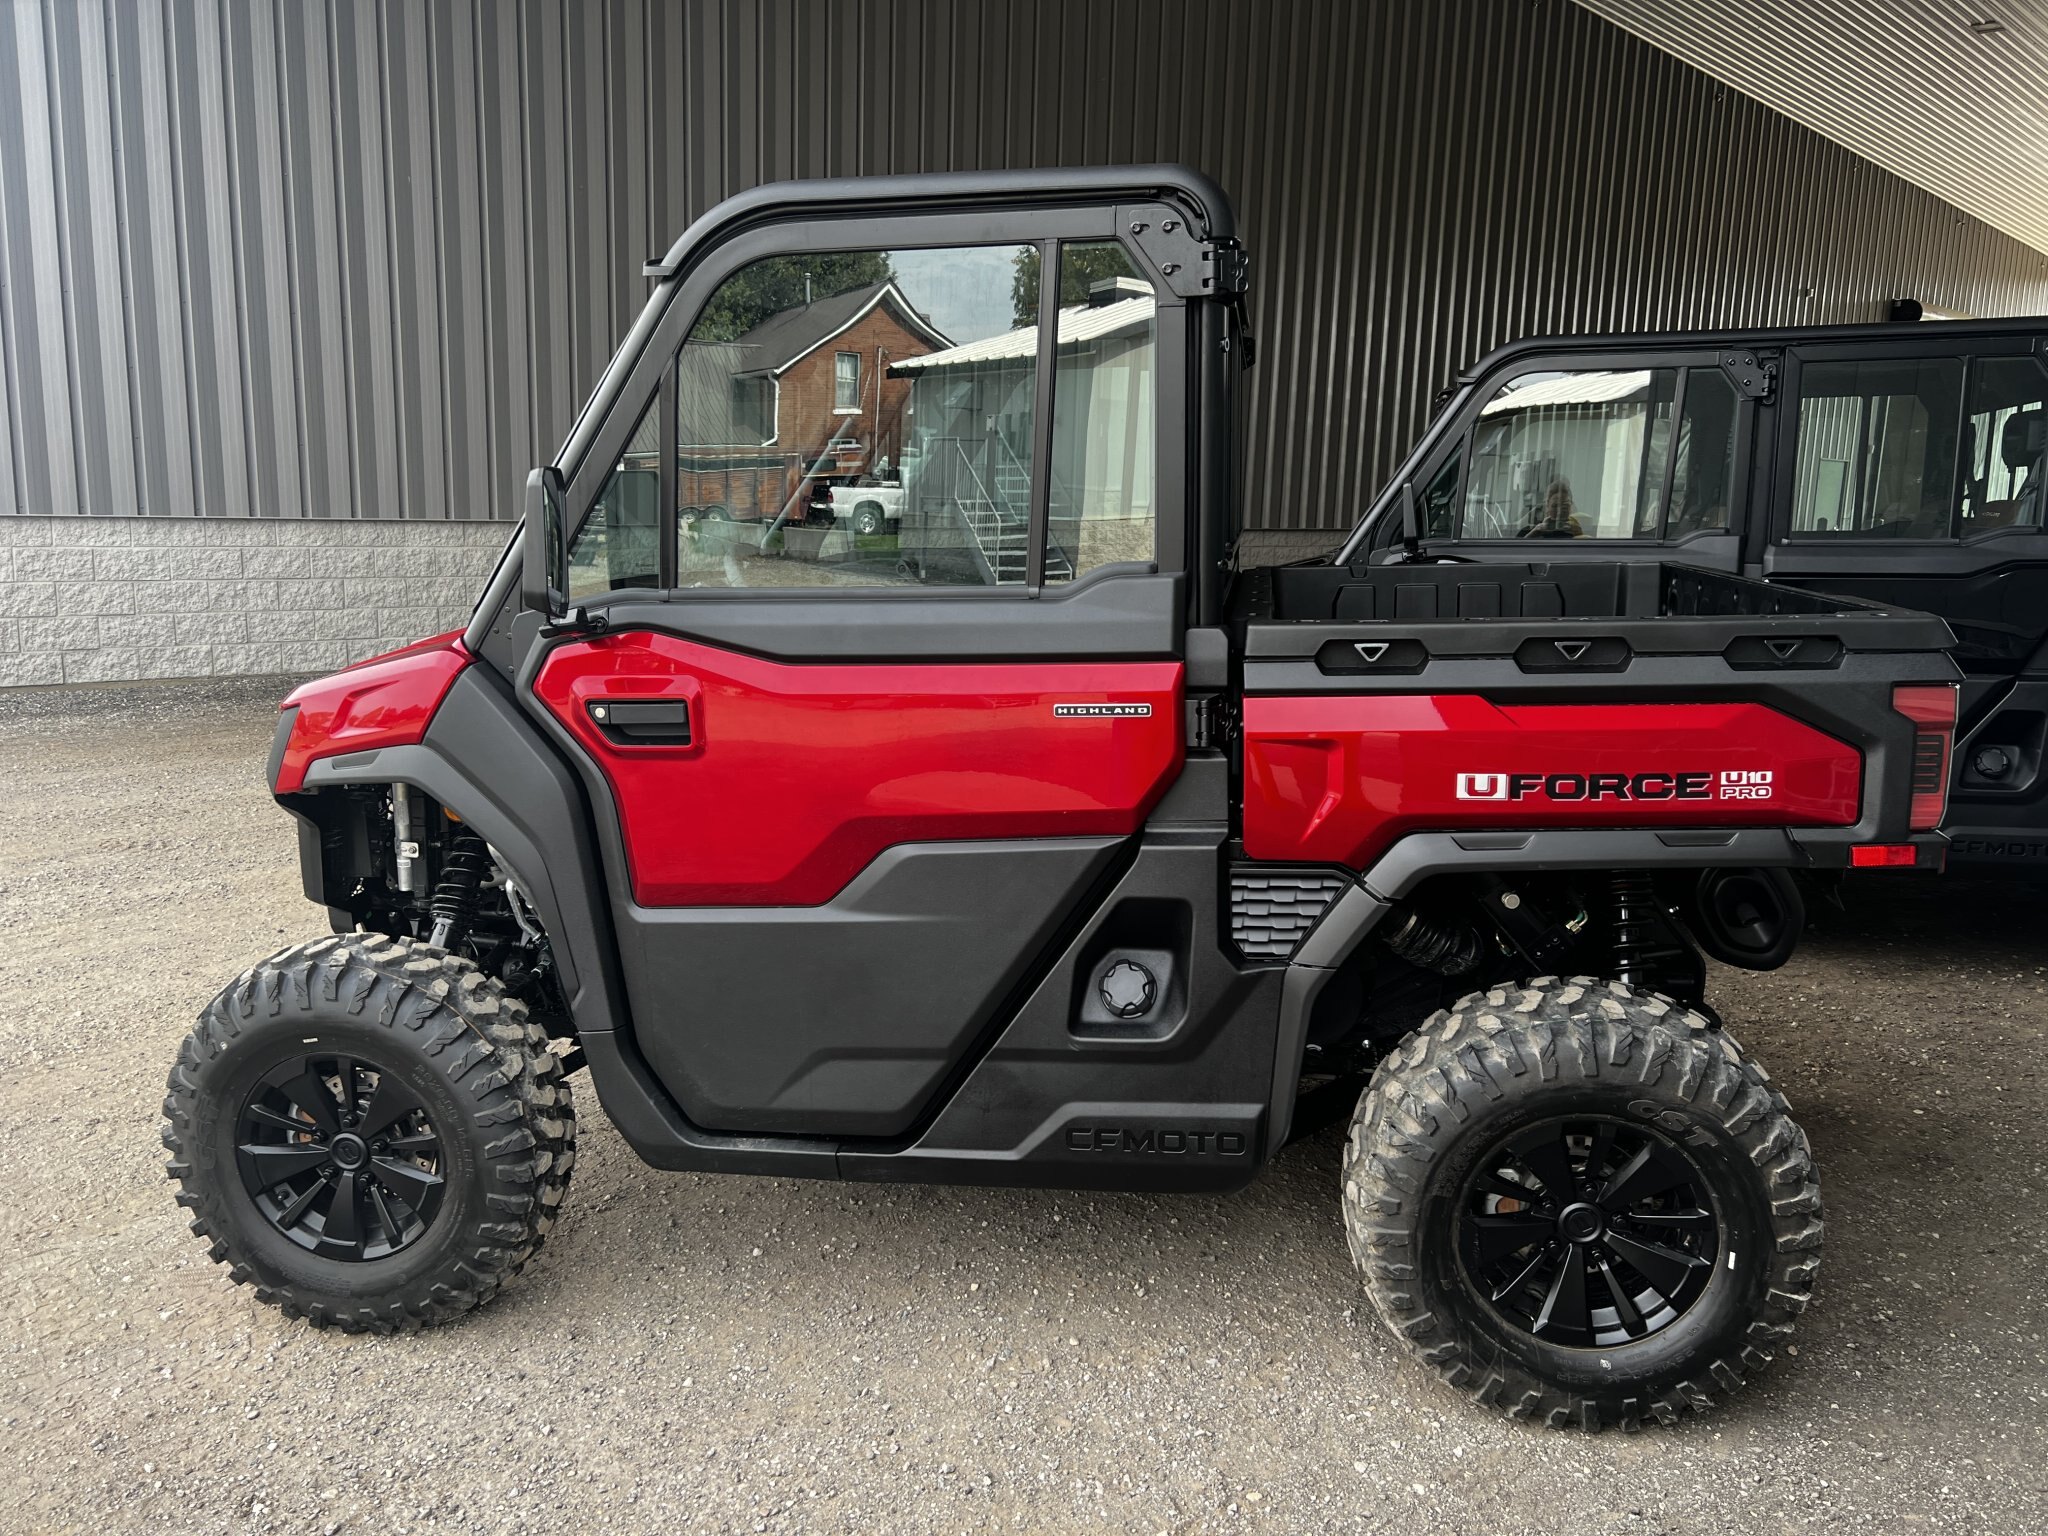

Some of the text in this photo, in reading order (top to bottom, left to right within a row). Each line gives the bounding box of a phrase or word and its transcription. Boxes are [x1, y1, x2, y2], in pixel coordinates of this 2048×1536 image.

[1056, 706, 1149, 715] HIGHLAND
[1720, 771, 1773, 785] U10
[1720, 786, 1772, 800] PRO
[1950, 840, 2048, 857] CFMOT
[1065, 1127, 1247, 1157] CFMOTO
